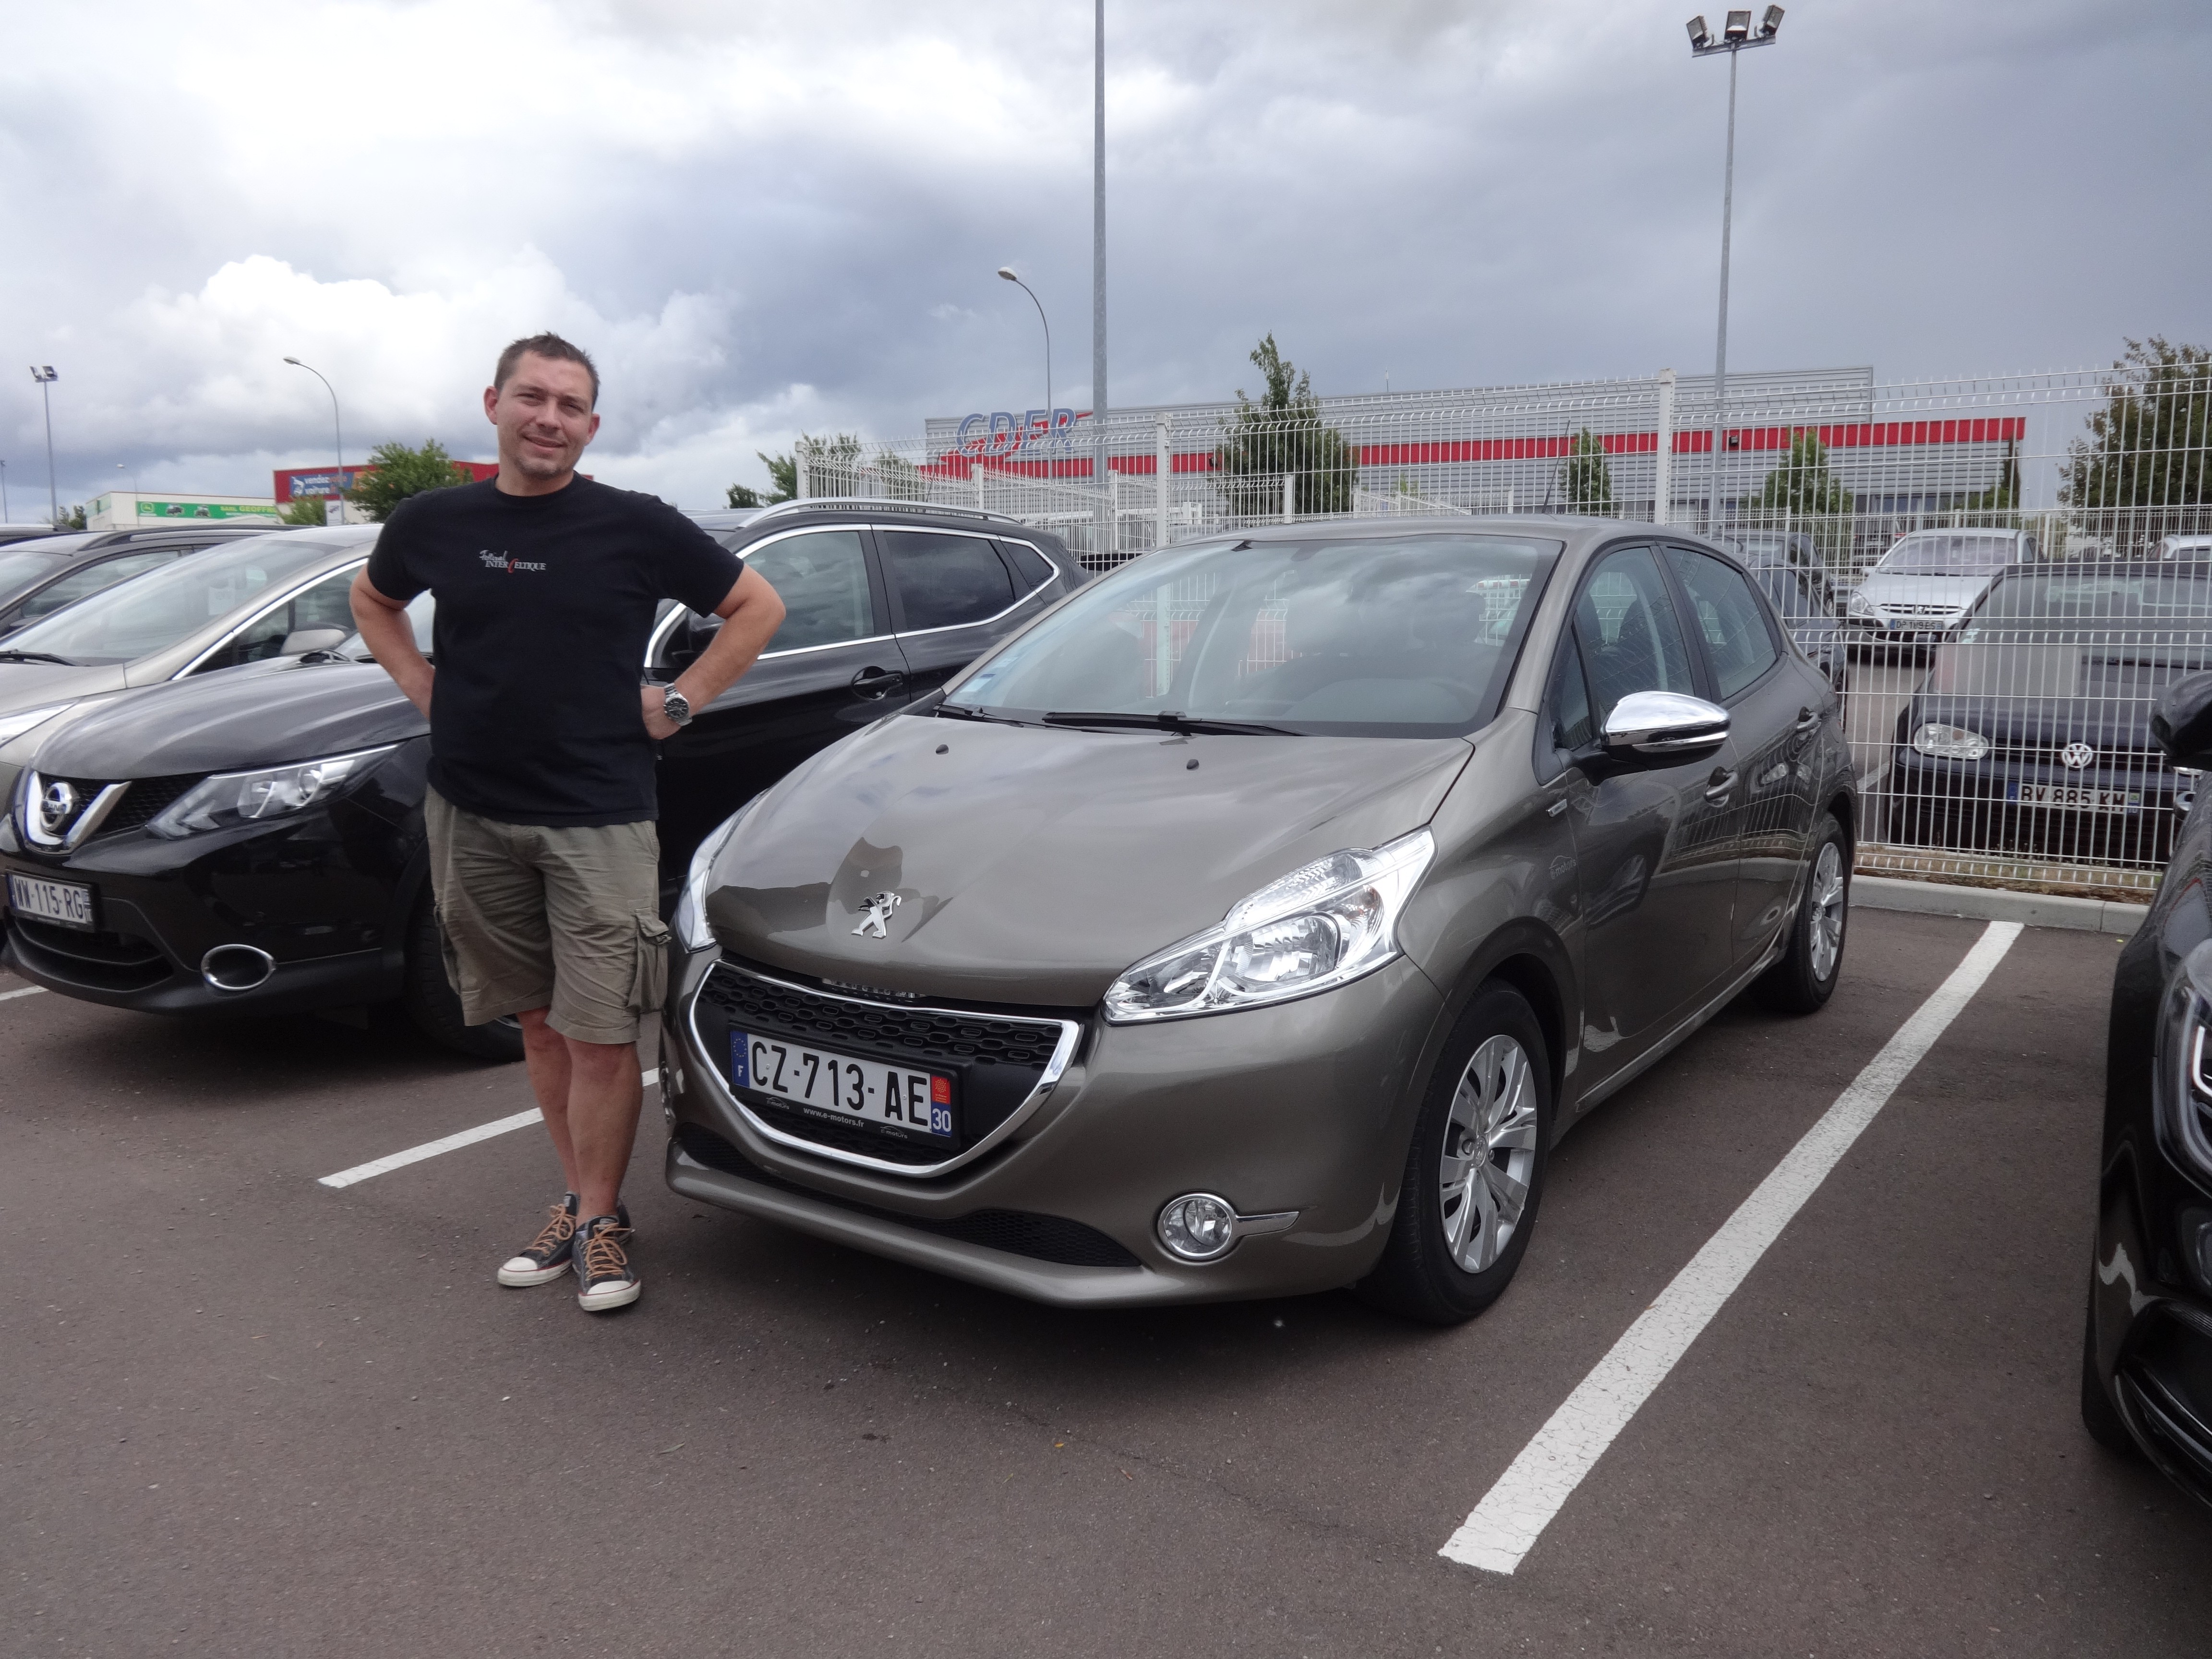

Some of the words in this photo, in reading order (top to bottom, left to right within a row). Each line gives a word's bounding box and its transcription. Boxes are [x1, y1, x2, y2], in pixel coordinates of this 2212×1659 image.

[956, 408, 1077, 457] CDER
[738, 1065, 744, 1077] F
[803, 1107, 865, 1128] www.e-motors.fr
[932, 1108, 951, 1132] 30
